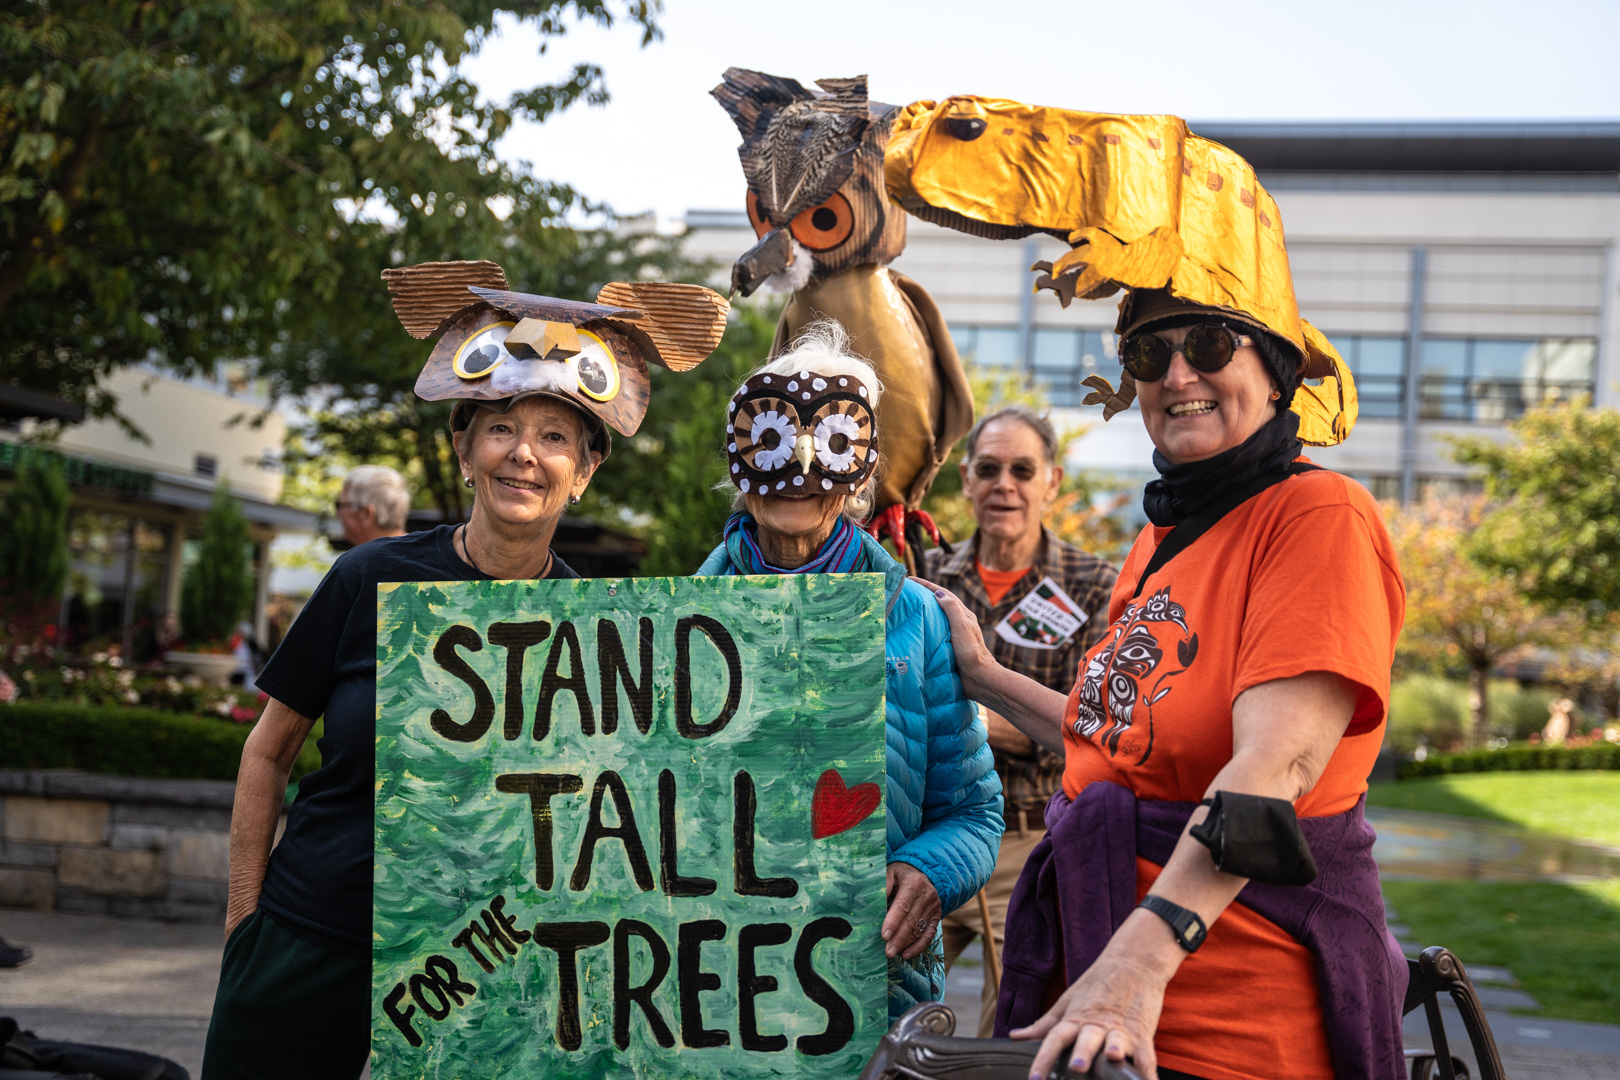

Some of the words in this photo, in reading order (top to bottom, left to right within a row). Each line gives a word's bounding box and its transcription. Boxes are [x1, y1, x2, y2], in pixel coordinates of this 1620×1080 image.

[430, 614, 742, 742] STAND
[495, 768, 799, 898] TALL
[383, 954, 477, 1047] FOR
[452, 894, 532, 973] THE
[533, 916, 855, 1056] TREES
